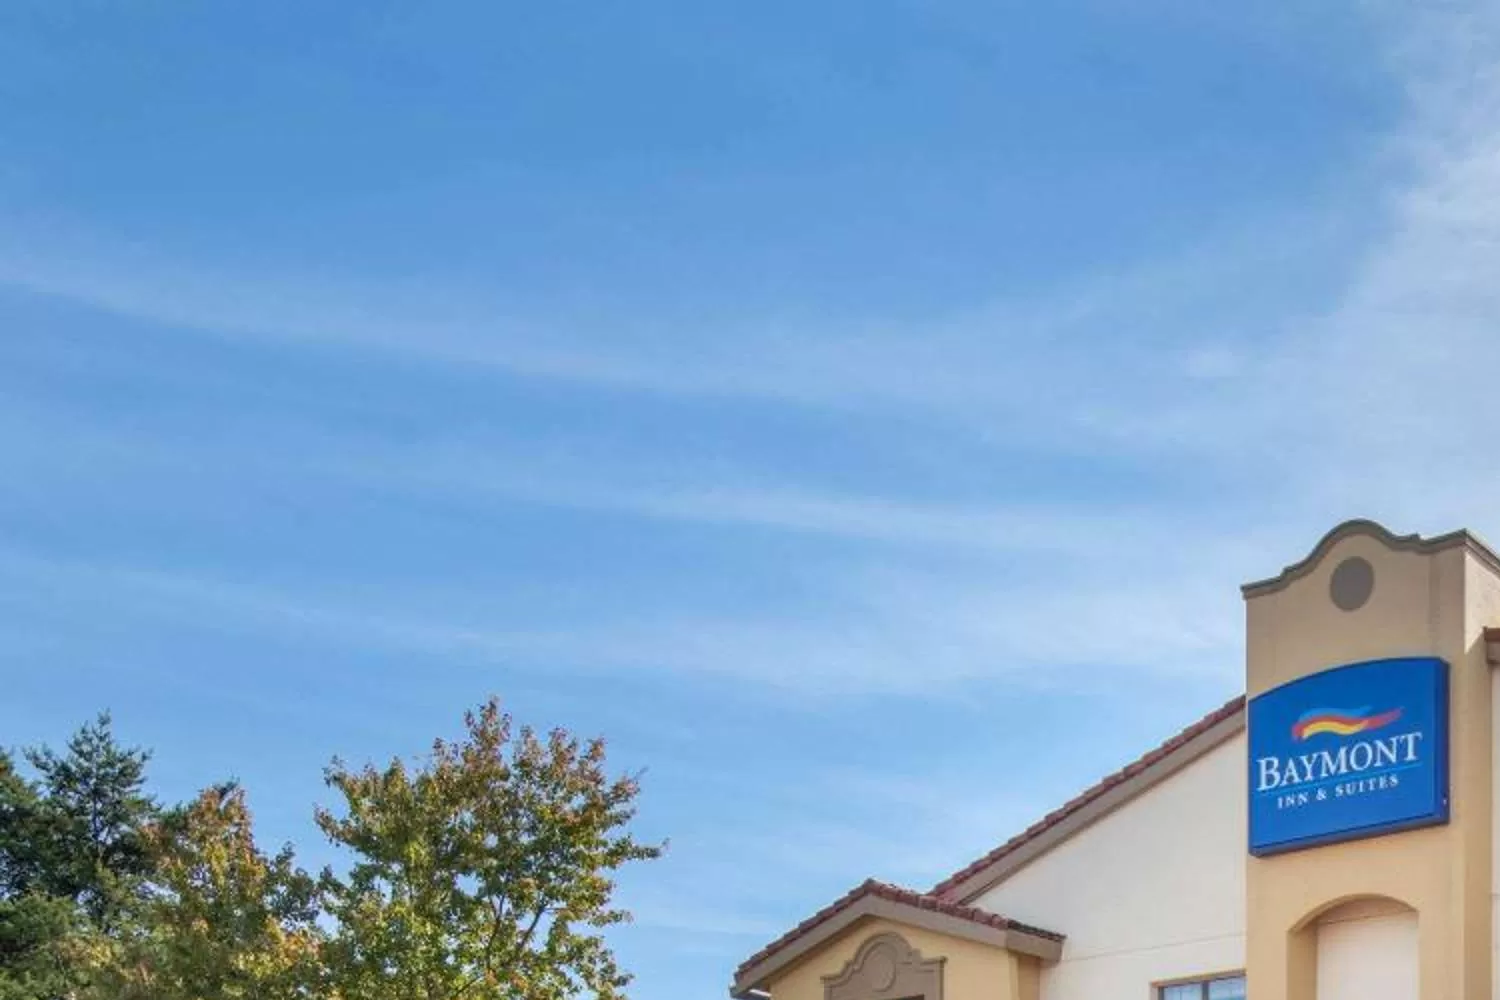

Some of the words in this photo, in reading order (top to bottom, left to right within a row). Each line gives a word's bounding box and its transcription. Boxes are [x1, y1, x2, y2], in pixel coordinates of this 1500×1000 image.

[1256, 731, 1423, 791] BAYMONT
[1277, 791, 1309, 809] INN
[1315, 787, 1328, 801] &
[1335, 774, 1399, 797] SUITES
